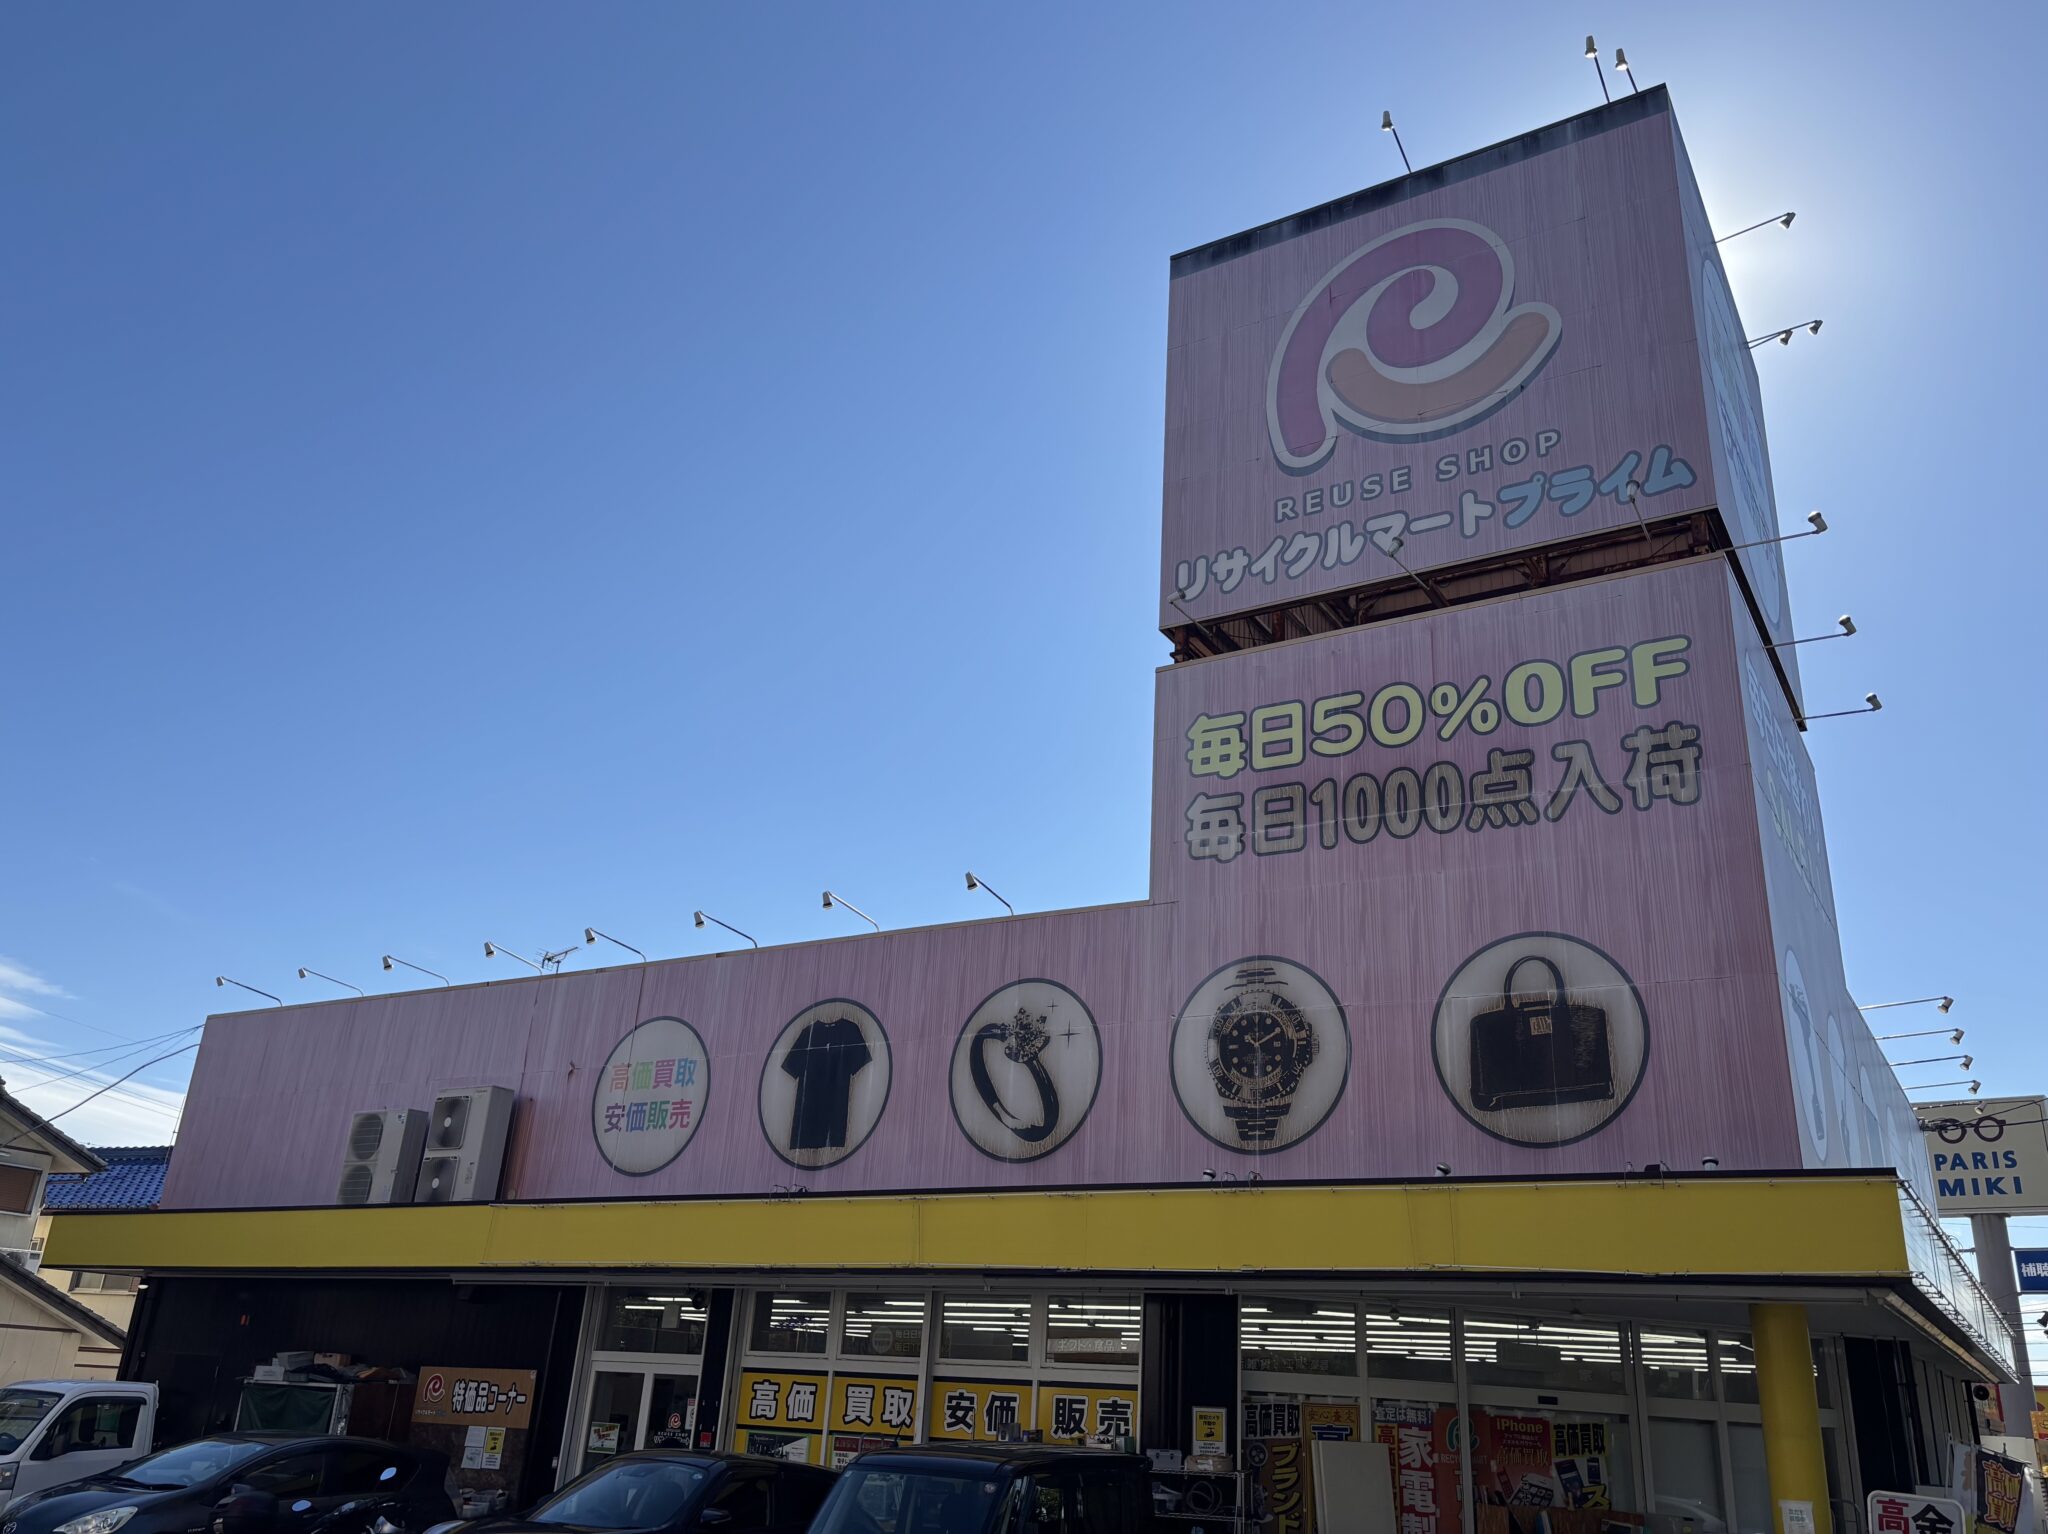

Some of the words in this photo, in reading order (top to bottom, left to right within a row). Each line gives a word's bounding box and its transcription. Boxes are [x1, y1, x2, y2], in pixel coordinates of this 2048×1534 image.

[1275, 466, 1413, 521] REUSE
[1436, 430, 1561, 480] SHOP
[1186, 636, 1692, 778] 毎日50%OFF
[1185, 721, 1701, 864] 毎日1000点入荷
[610, 1057, 698, 1092] 高価買取
[604, 1099, 693, 1133] 安価販売
[1934, 1150, 2018, 1171] PARIS
[1938, 1176, 2023, 1197] MIKI
[452, 1379, 528, 1415] 特価品コーナー
[1245, 1404, 1300, 1439] 高価買取
[1496, 1417, 1544, 1434] iPhone
[1553, 1423, 1605, 1457] 高価買取
[1271, 1441, 1300, 1534] ブランド
